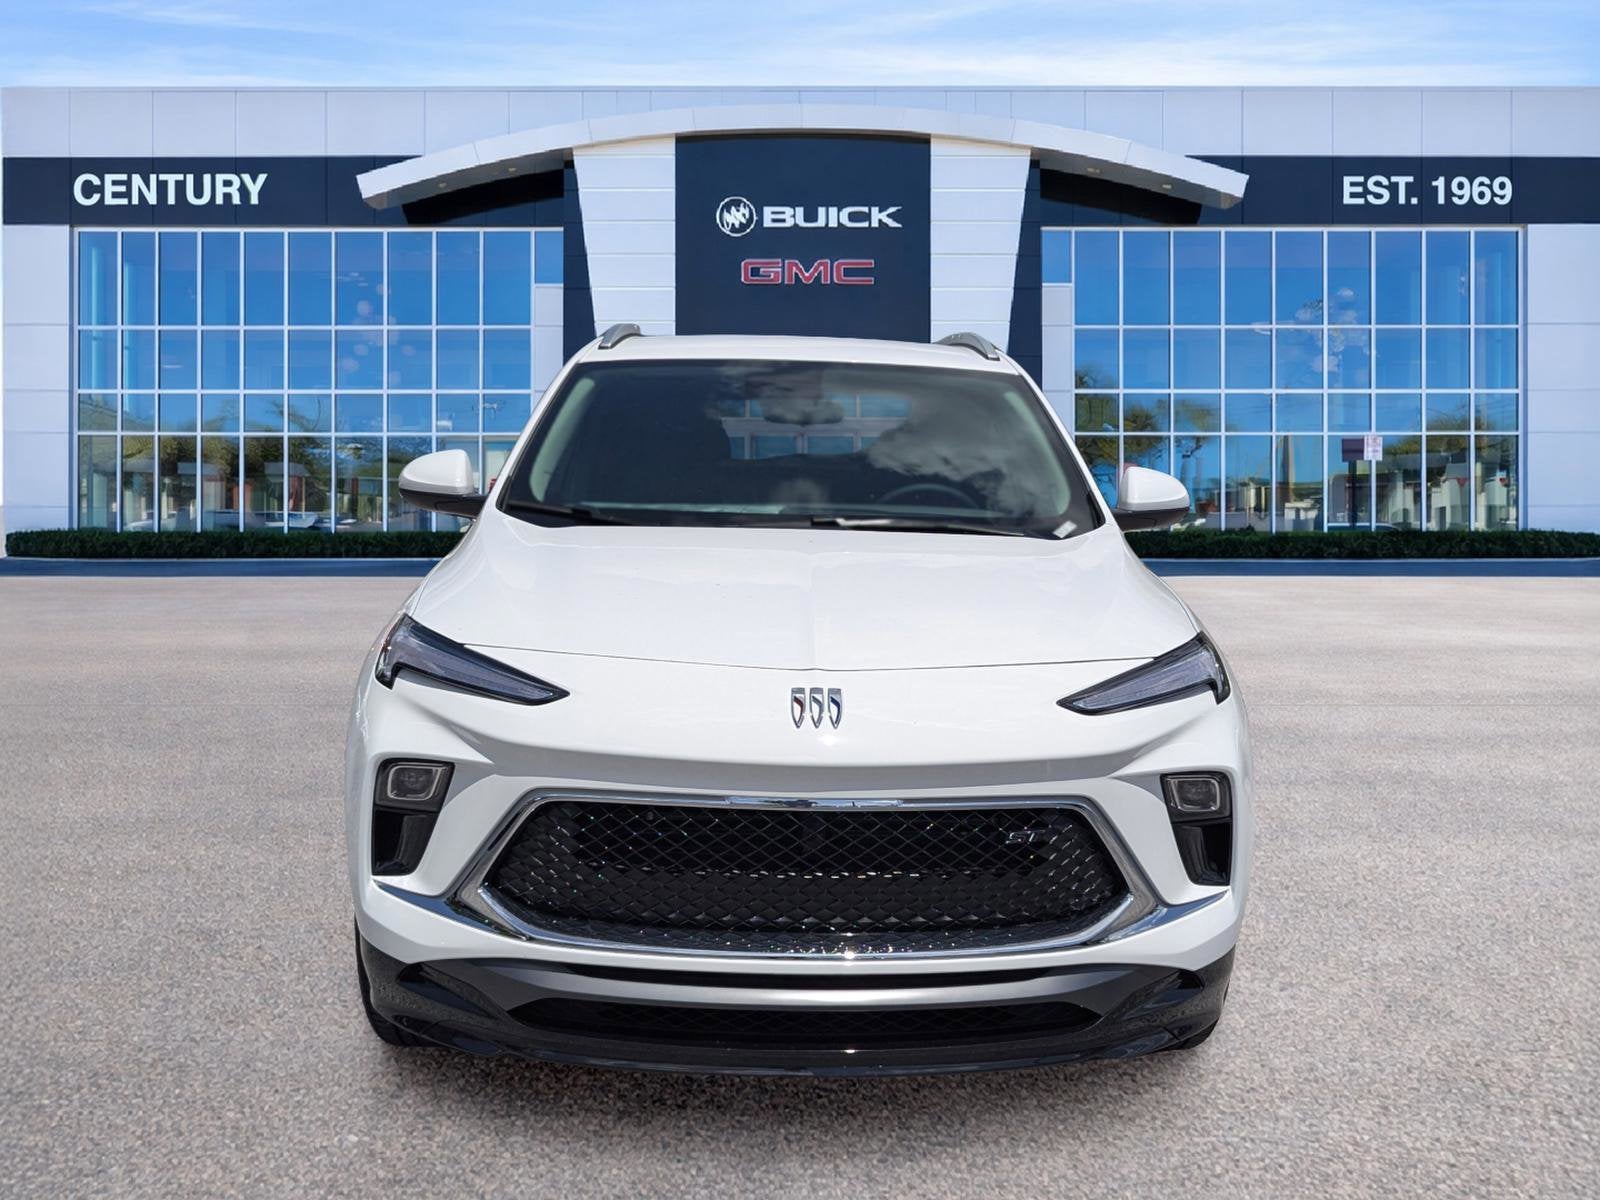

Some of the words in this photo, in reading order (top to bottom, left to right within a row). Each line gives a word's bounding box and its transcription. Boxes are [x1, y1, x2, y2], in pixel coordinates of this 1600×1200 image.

[73, 173, 268, 206] CENTURY
[1342, 175, 1418, 206] EST.
[1431, 175, 1513, 206] 1969
[763, 206, 903, 228] BUICK
[741, 258, 875, 285] GMC
